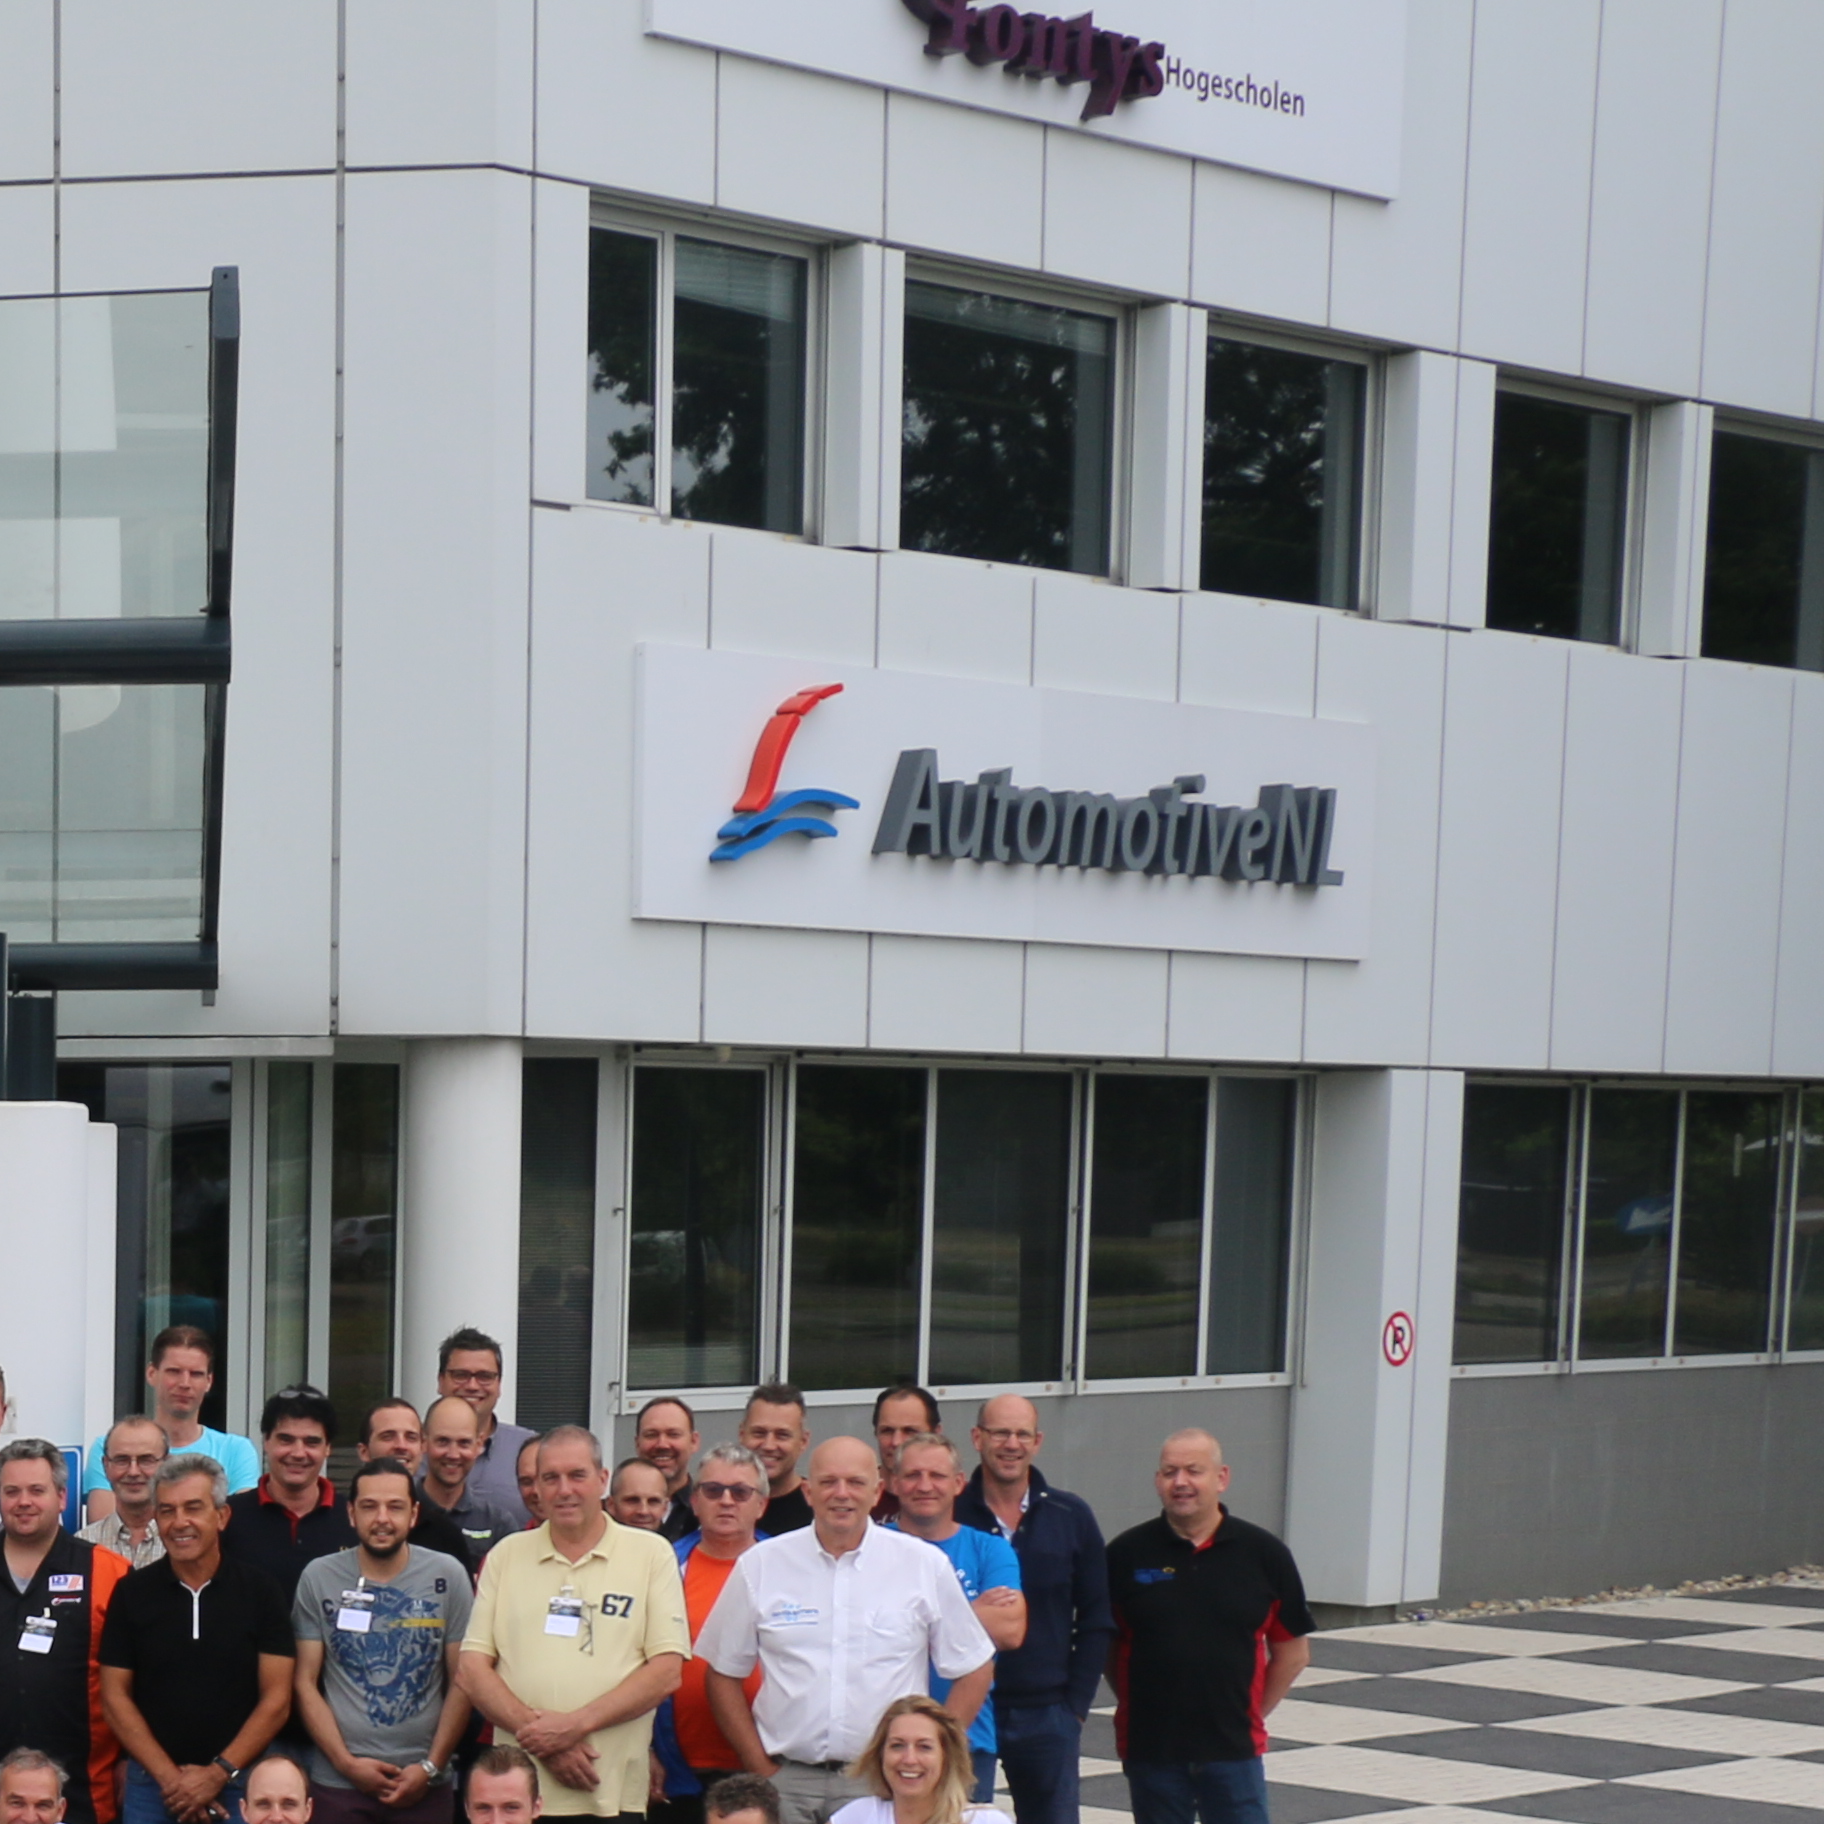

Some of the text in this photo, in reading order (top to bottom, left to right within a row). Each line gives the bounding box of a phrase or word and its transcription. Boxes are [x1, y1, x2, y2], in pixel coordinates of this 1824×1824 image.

[1165, 56, 1306, 117] Hogescholen
[871, 747, 1344, 886] AutomotiveNL
[601, 1593, 635, 1619] 67
